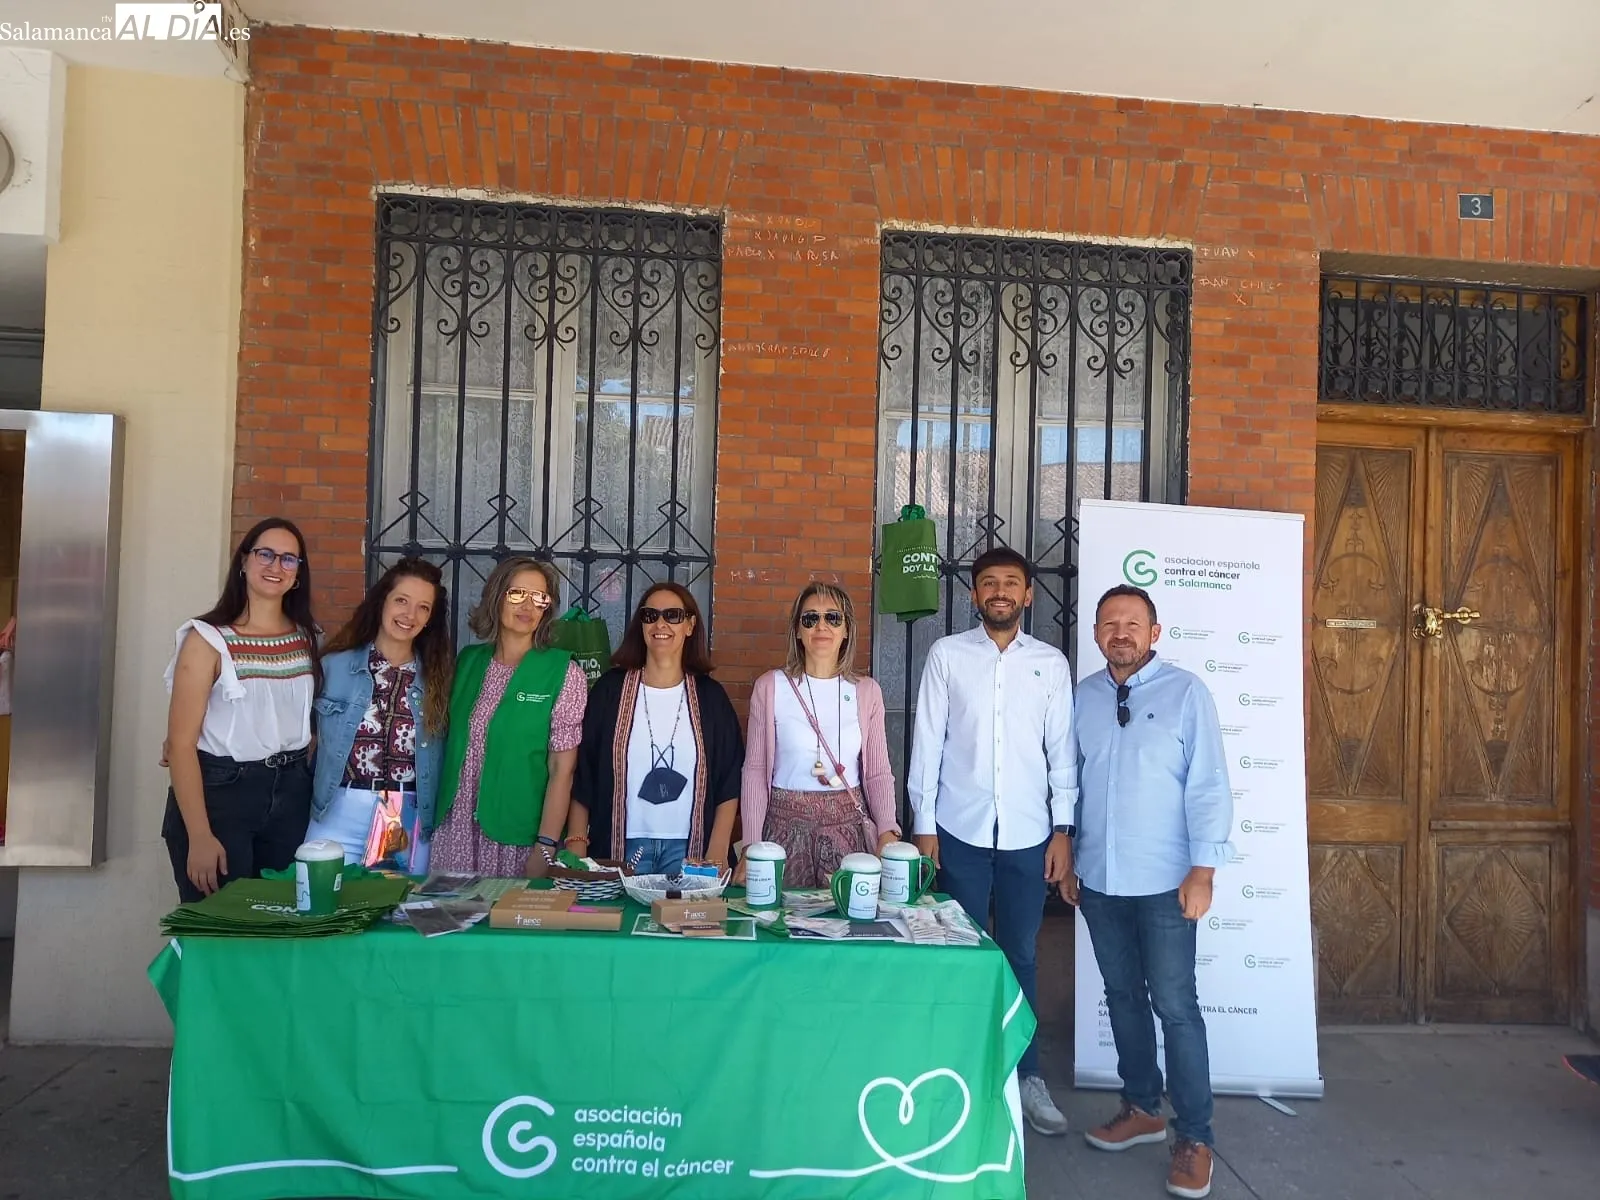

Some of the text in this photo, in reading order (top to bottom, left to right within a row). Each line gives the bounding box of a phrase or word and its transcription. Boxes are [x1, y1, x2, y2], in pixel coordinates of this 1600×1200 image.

[1471, 197, 1482, 216] 3
[902, 563, 936, 574] DOY LA
[1164, 556, 1261, 570] asociación española
[1164, 567, 1240, 580] contra el cáncer
[1164, 578, 1232, 591] en Salamanca
[1218, 1005, 1227, 1014] EL
[574, 1104, 682, 1128] asociación
[573, 1129, 666, 1152] española
[571, 1155, 735, 1178] contra el cáncer
